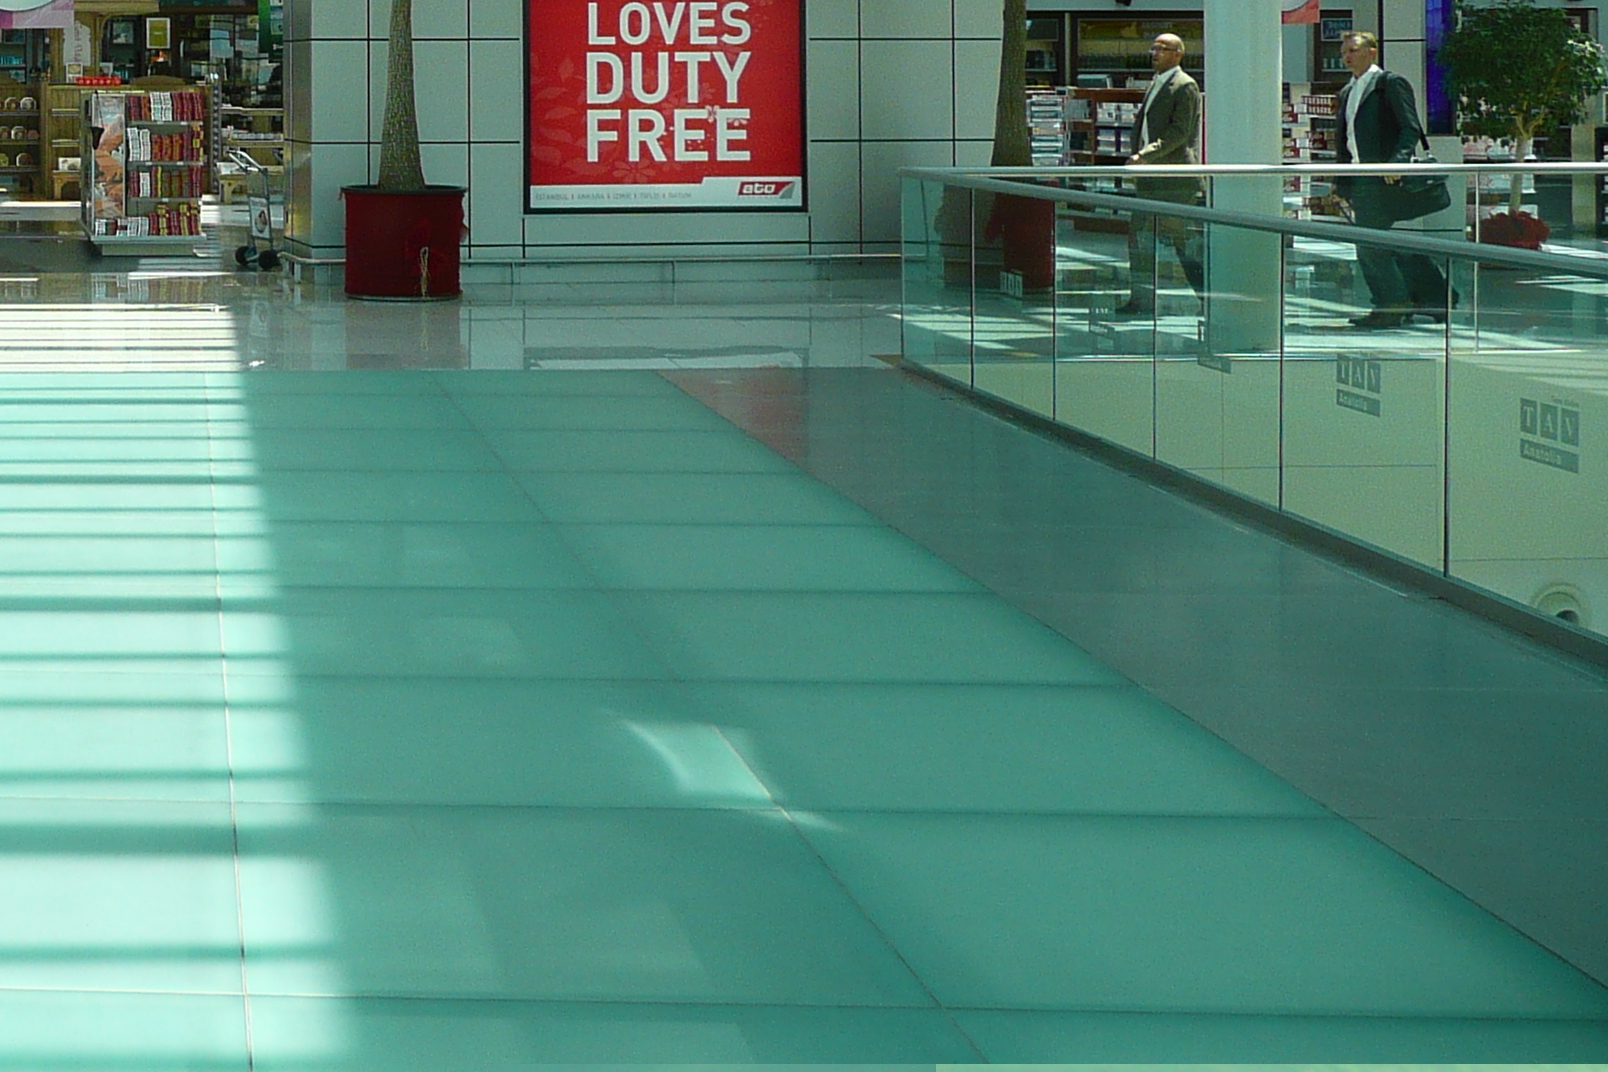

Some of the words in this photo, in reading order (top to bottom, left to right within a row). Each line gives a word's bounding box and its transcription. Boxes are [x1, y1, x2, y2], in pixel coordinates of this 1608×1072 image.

[588, 1, 751, 45] LOVES
[586, 51, 752, 104] DUTY
[586, 109, 751, 162] FREE
